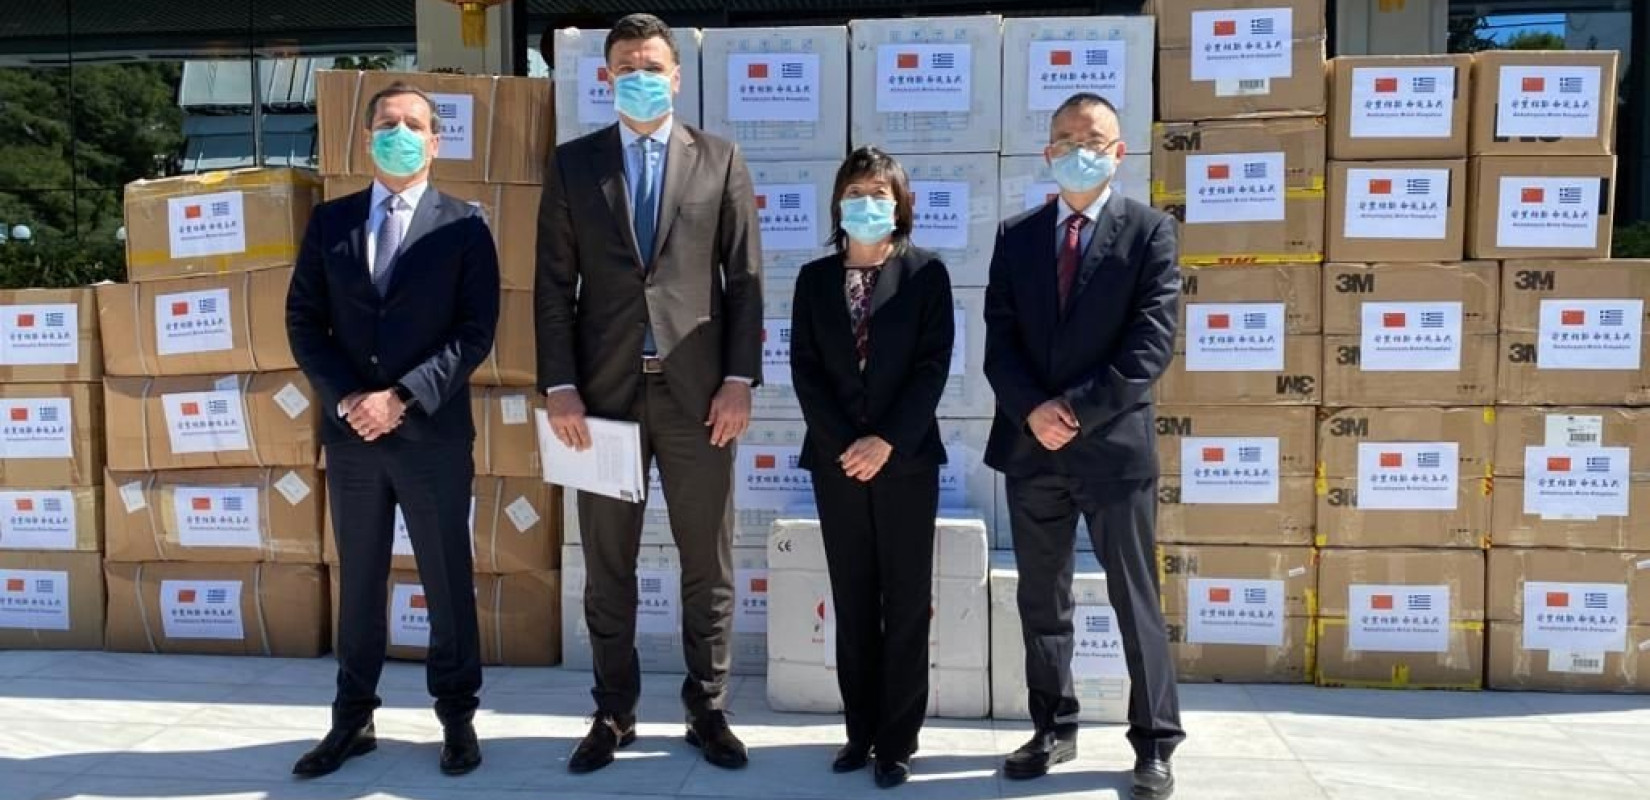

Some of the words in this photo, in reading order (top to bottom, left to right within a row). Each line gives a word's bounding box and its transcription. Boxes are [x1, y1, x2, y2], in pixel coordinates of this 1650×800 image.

[1163, 131, 1201, 150] 3M
[1336, 274, 1374, 293] 3M
[1515, 270, 1555, 291] 3M
[1276, 375, 1314, 395] 3M
[1156, 416, 1191, 435] 3M
[1330, 418, 1368, 437] 3M
[777, 540, 792, 553] CE
